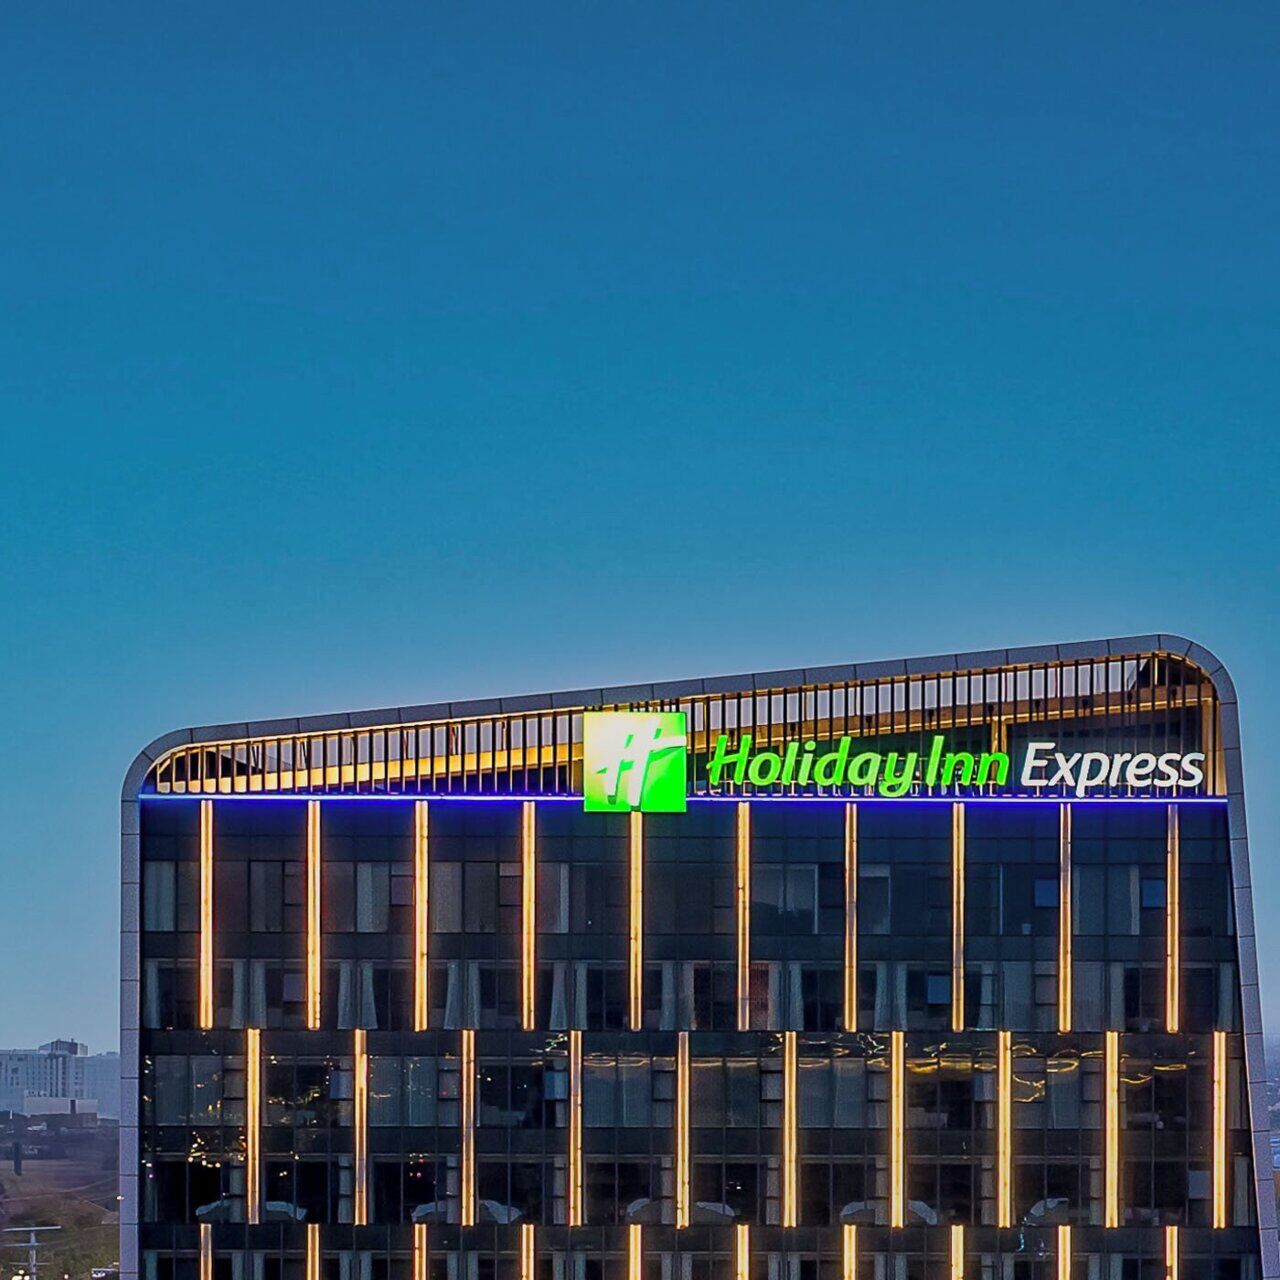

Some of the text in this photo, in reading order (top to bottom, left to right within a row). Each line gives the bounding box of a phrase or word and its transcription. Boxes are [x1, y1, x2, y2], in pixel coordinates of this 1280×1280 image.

[706, 734, 918, 797] Holiday
[926, 734, 1010, 787] Inn
[1020, 742, 1205, 798] Express
